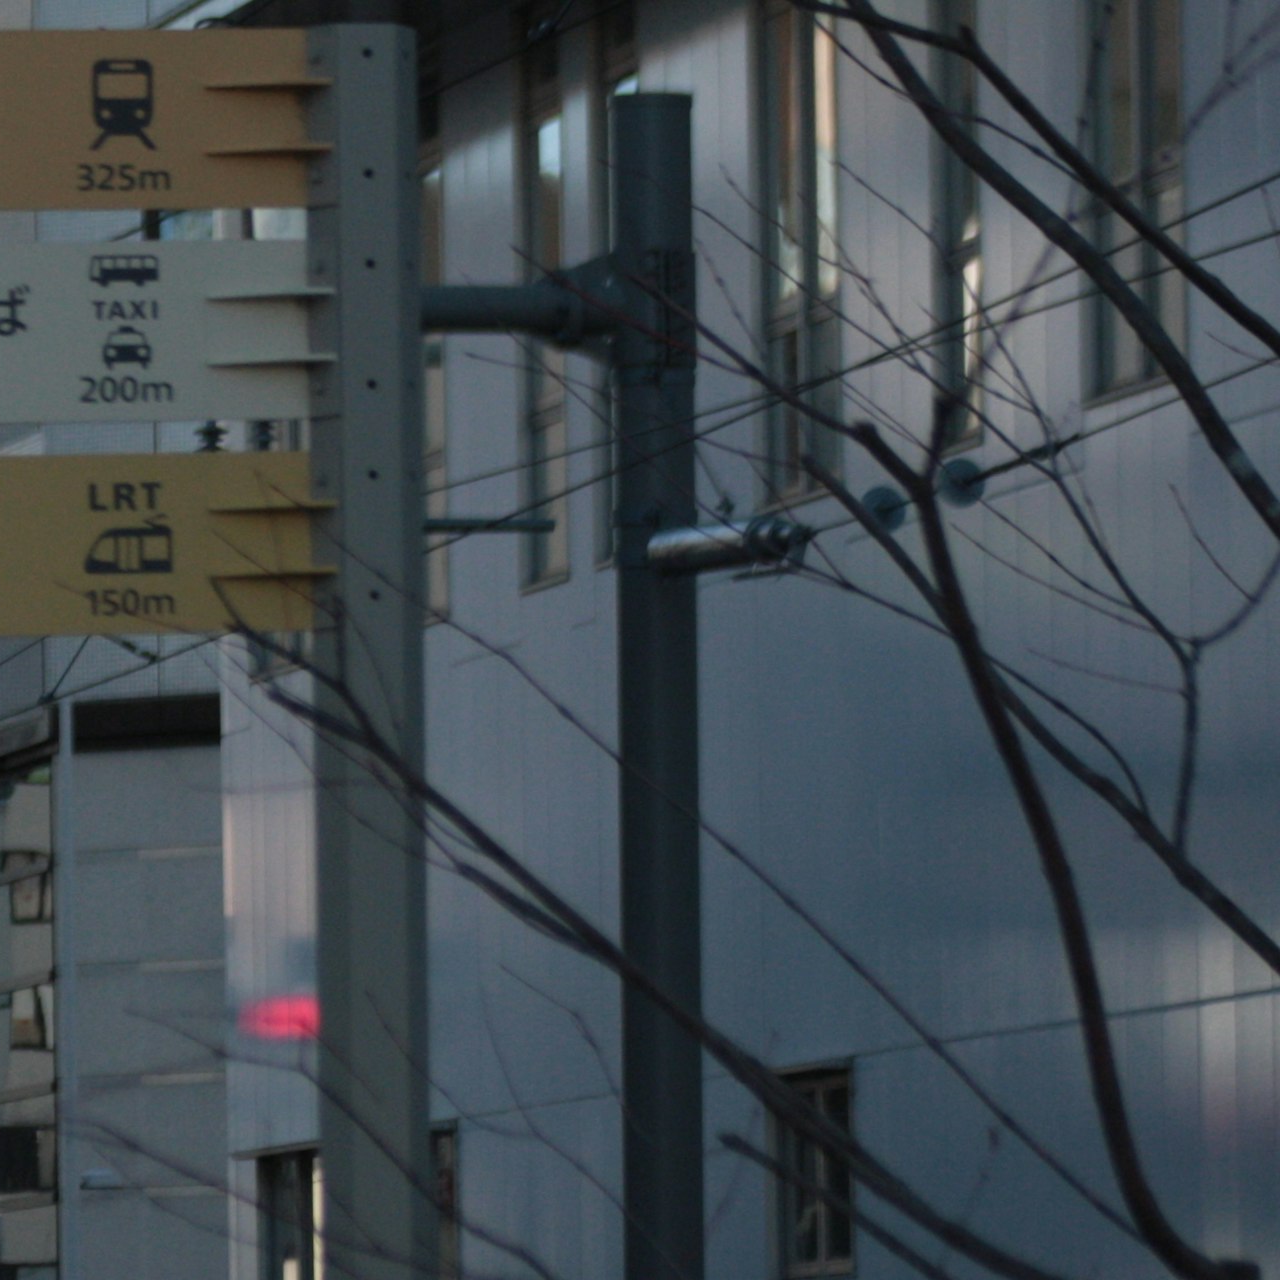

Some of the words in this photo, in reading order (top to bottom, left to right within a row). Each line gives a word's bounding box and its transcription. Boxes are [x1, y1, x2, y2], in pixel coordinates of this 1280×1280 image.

[77, 163, 172, 191] 325m
[93, 300, 159, 320] TAXI
[80, 375, 174, 403] 200m
[89, 482, 162, 511] LRT
[85, 587, 176, 617] 150m
